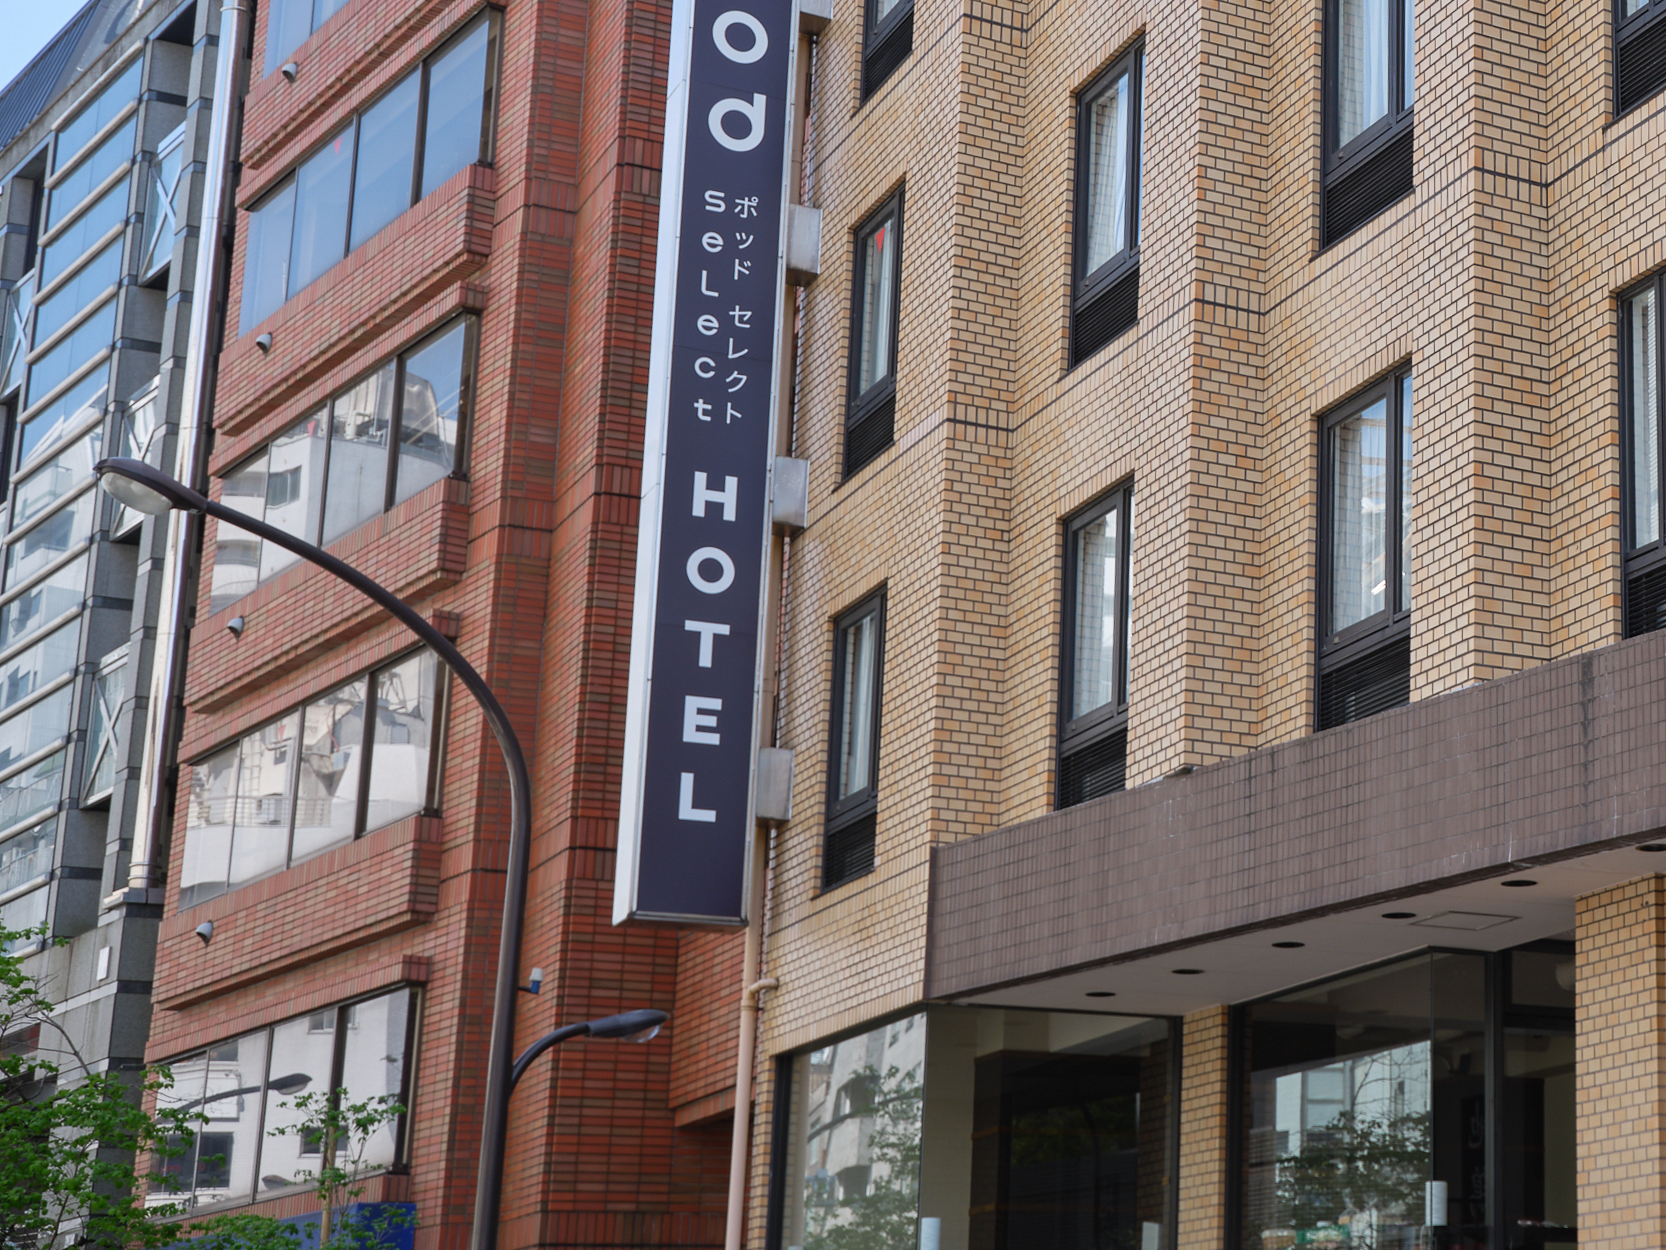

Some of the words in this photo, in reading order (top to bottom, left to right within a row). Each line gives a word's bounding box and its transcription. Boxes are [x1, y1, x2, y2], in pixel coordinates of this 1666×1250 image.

[733, 196, 759, 280] ポッド
[725, 305, 752, 424] セレクト
[678, 471, 738, 822] HOTEL
